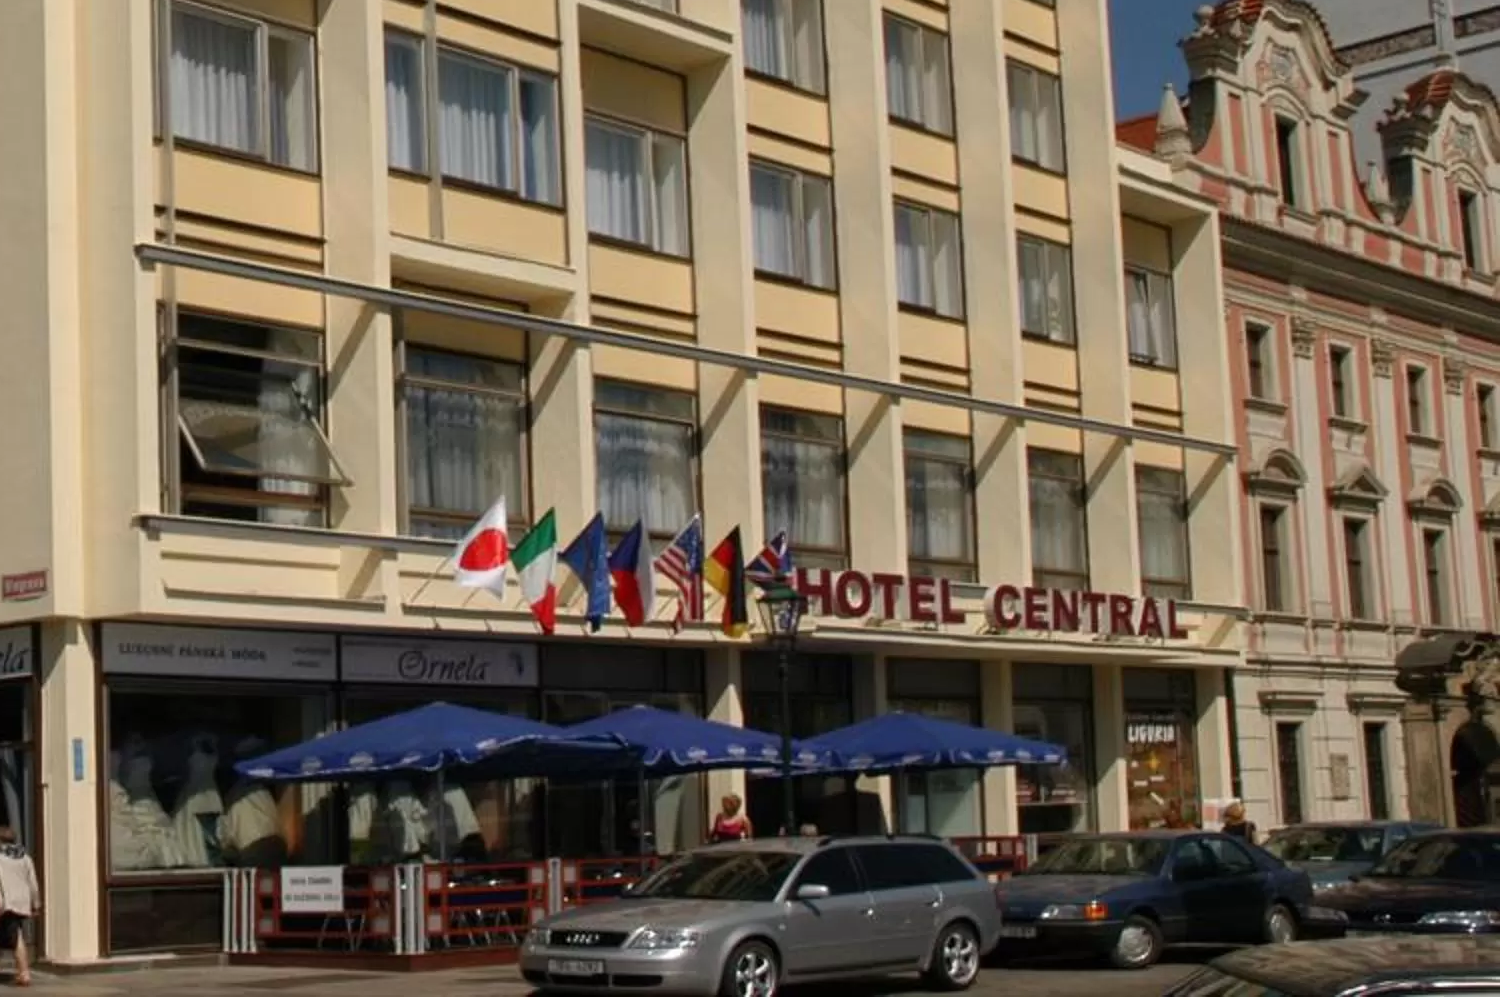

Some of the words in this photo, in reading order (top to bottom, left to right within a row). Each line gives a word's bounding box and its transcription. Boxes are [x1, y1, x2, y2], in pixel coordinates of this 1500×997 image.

[796, 567, 966, 624] HOTEL
[993, 584, 1189, 640] CENTRAL
[397, 648, 490, 681] Ornela
